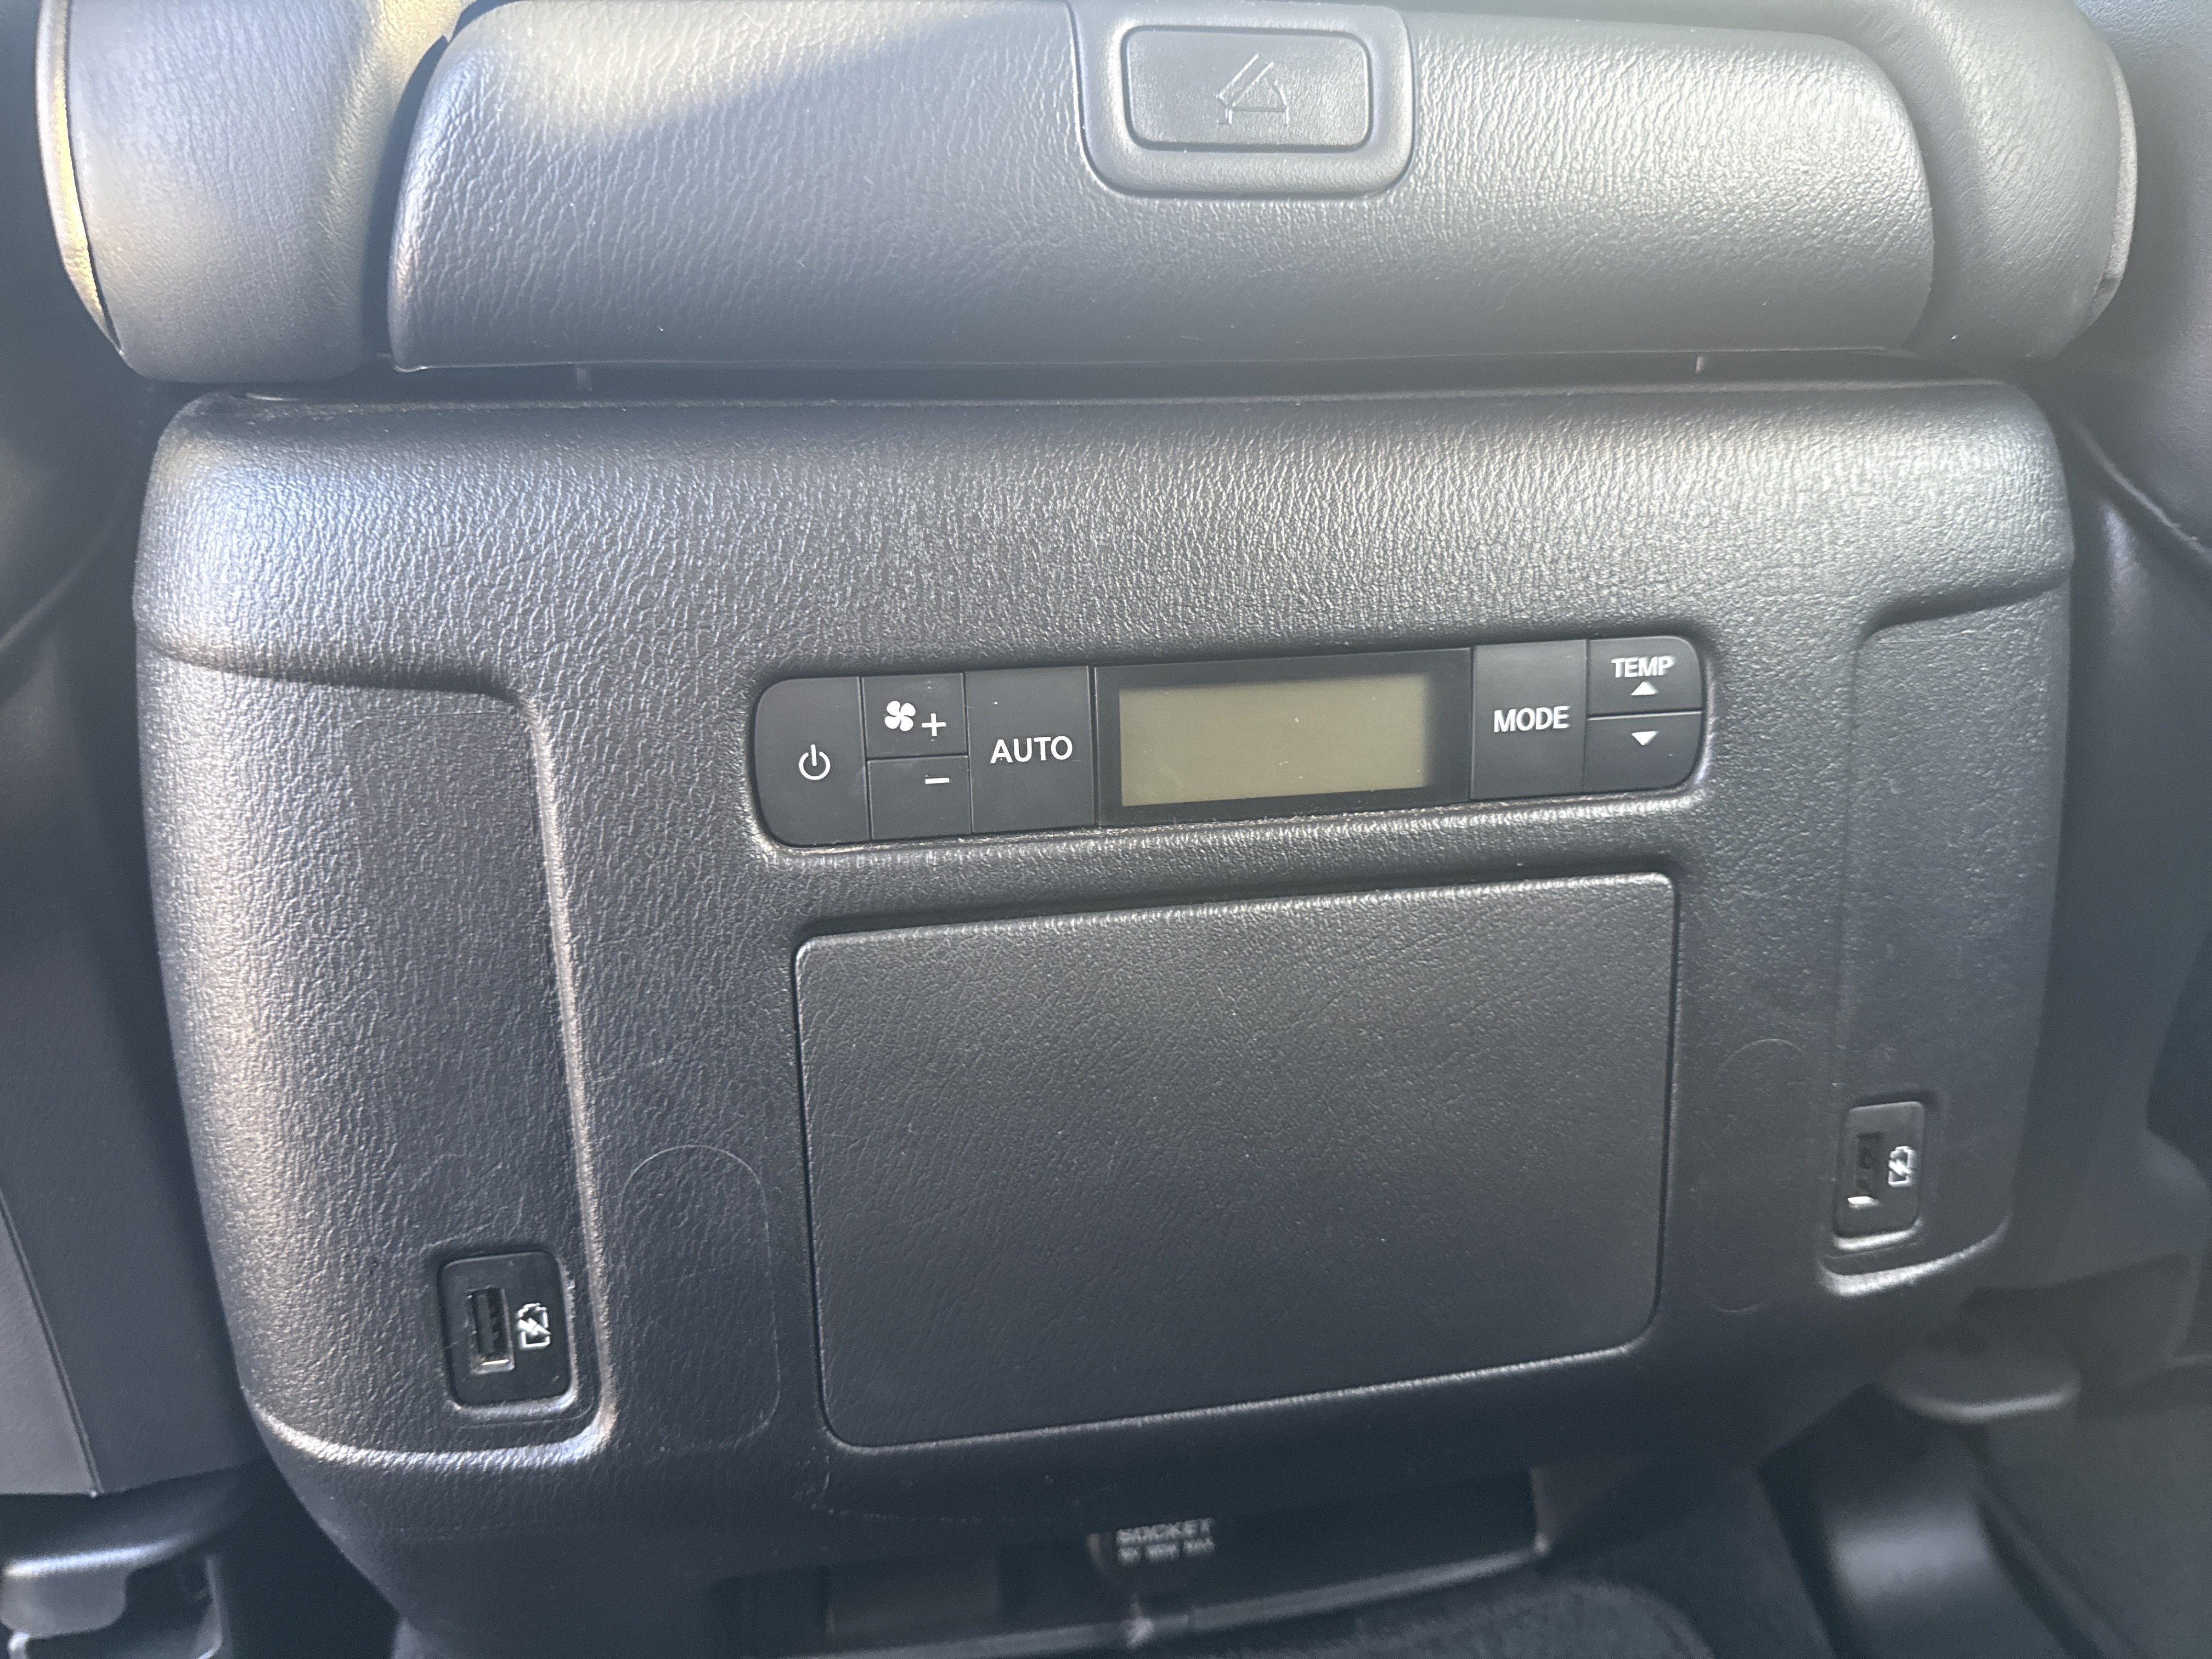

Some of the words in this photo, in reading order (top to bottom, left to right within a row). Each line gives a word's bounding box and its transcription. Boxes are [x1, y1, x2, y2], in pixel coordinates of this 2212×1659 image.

[1611, 656, 1676, 678] TEMP
[1494, 706, 1570, 732] MODE
[990, 735, 1073, 764] AUTO
